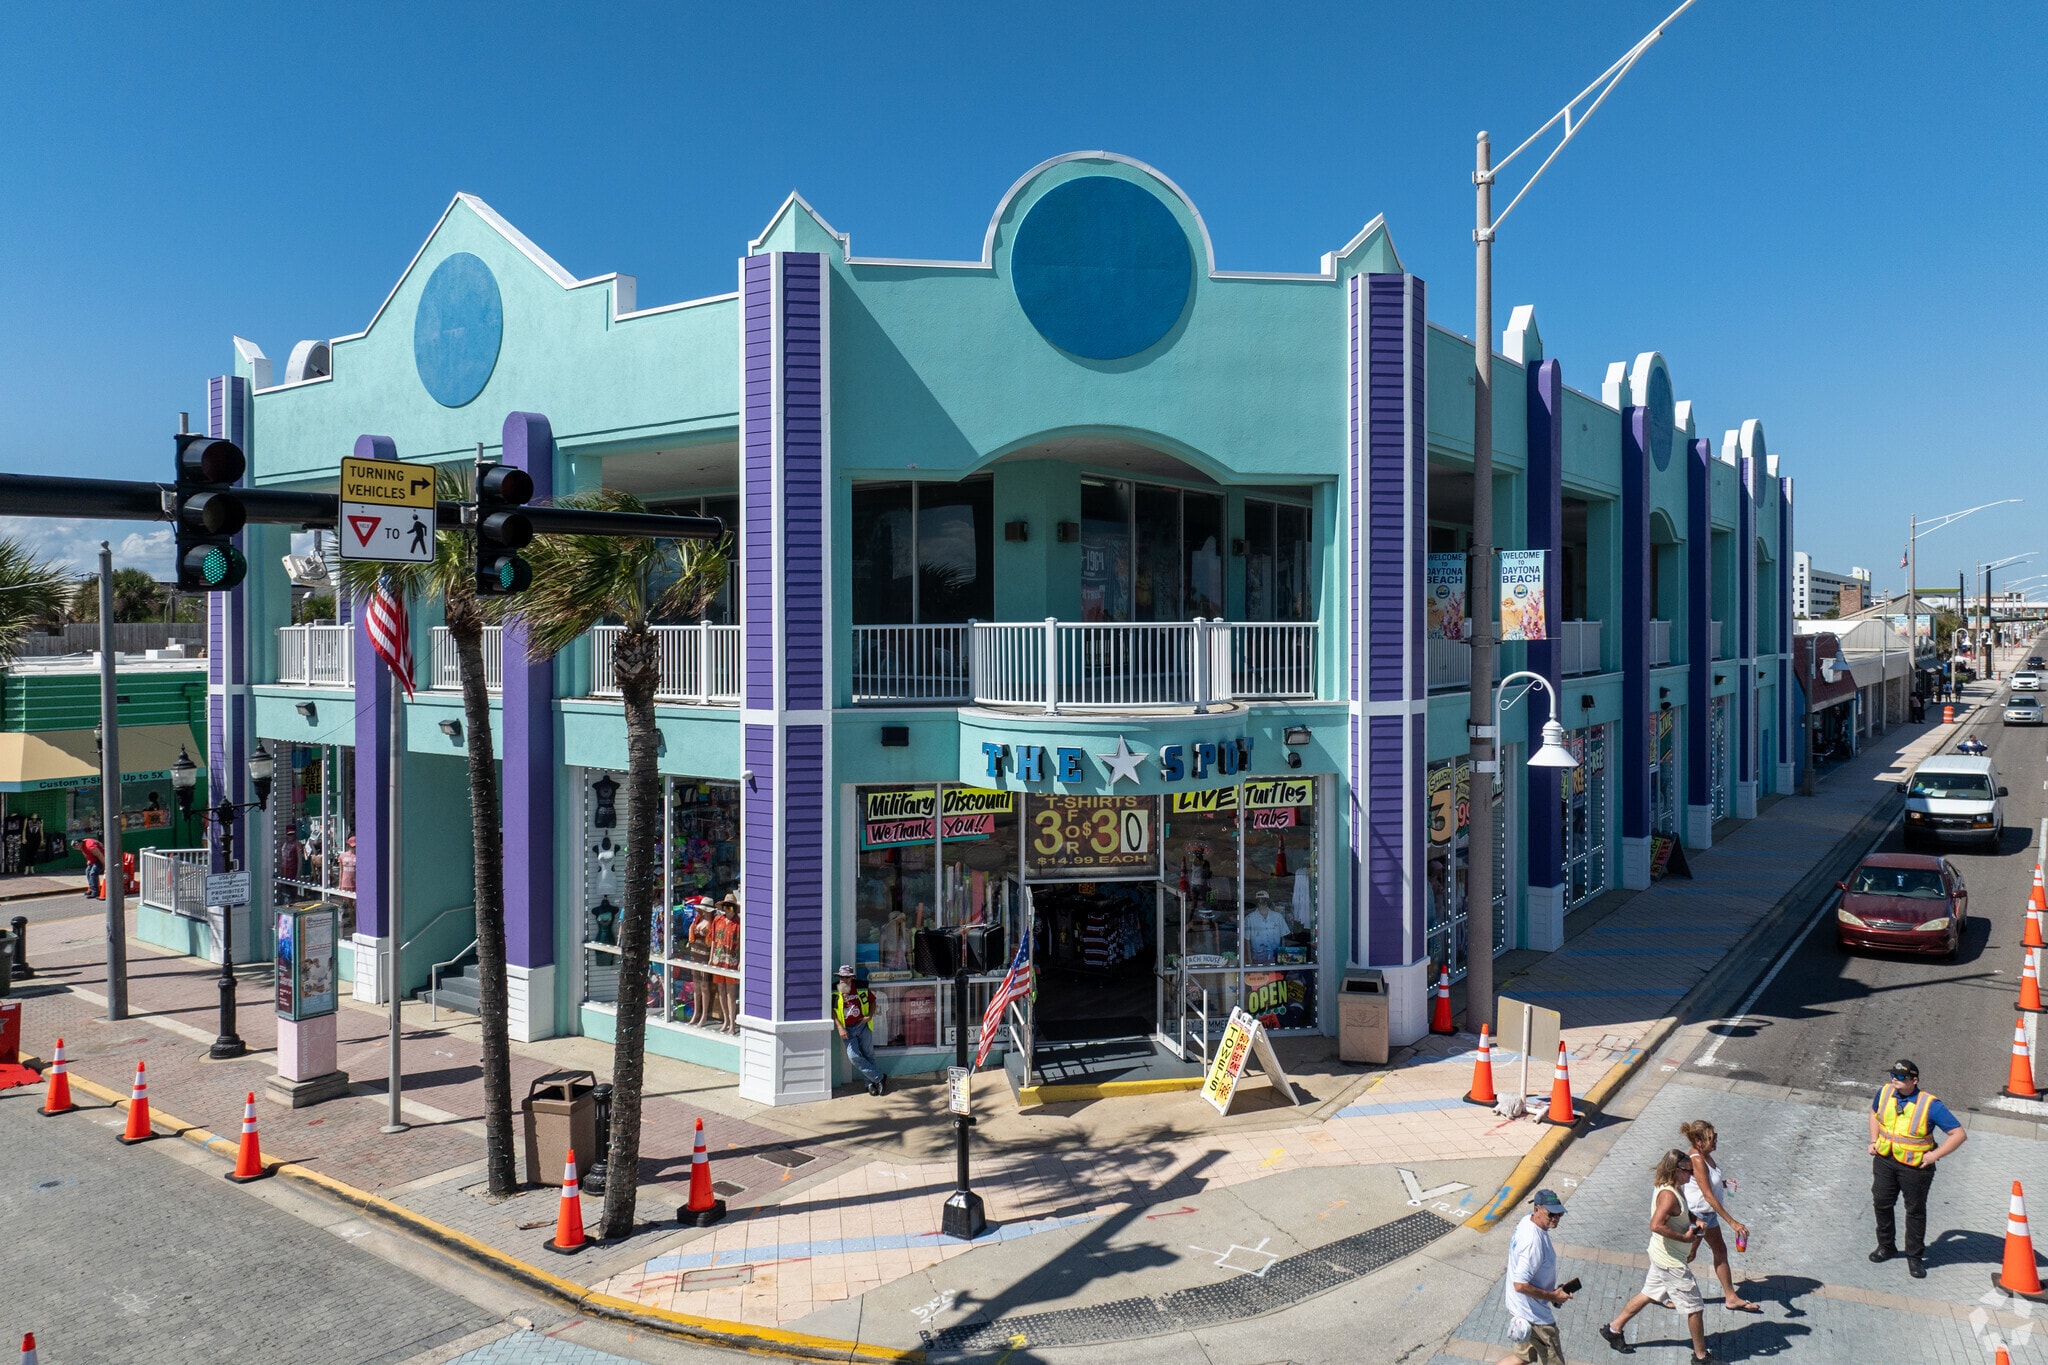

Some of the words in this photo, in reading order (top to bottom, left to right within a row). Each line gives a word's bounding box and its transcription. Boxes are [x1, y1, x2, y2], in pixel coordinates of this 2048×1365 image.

[350, 466, 404, 481] TURNING
[348, 484, 405, 499] VEHICLES
[385, 528, 400, 539] TO
[1427, 553, 1463, 561] WELCOME
[1502, 566, 1541, 575] DAYTONA
[1502, 575, 1541, 584] BEACH
[982, 741, 1084, 783] THE
[1160, 737, 1254, 782] SPOT
[39, 779, 79, 790] Custom
[123, 774, 137, 783] Up
[139, 773, 149, 781] to
[151, 772, 164, 780] 5X
[1045, 796, 1137, 809] T-SHIRTS
[1178, 786, 1237, 810] LIVE
[1245, 782, 1307, 806] Turtles
[869, 792, 936, 818] Military
[943, 790, 1012, 814] Discount
[871, 825, 890, 842] We
[892, 820, 932, 839] Thank
[943, 815, 990, 837] You!!
[1034, 810, 1064, 855] 3
[1065, 809, 1080, 855] FOR
[1037, 856, 1094, 866] $14.99
[1098, 855, 1147, 864] EACH
[211, 887, 245, 896] PROHIBITED
[1203, 955, 1221, 965] HOUSE
[1249, 980, 1288, 1013] OPEN
[1209, 1026, 1239, 1092] TOWELS
